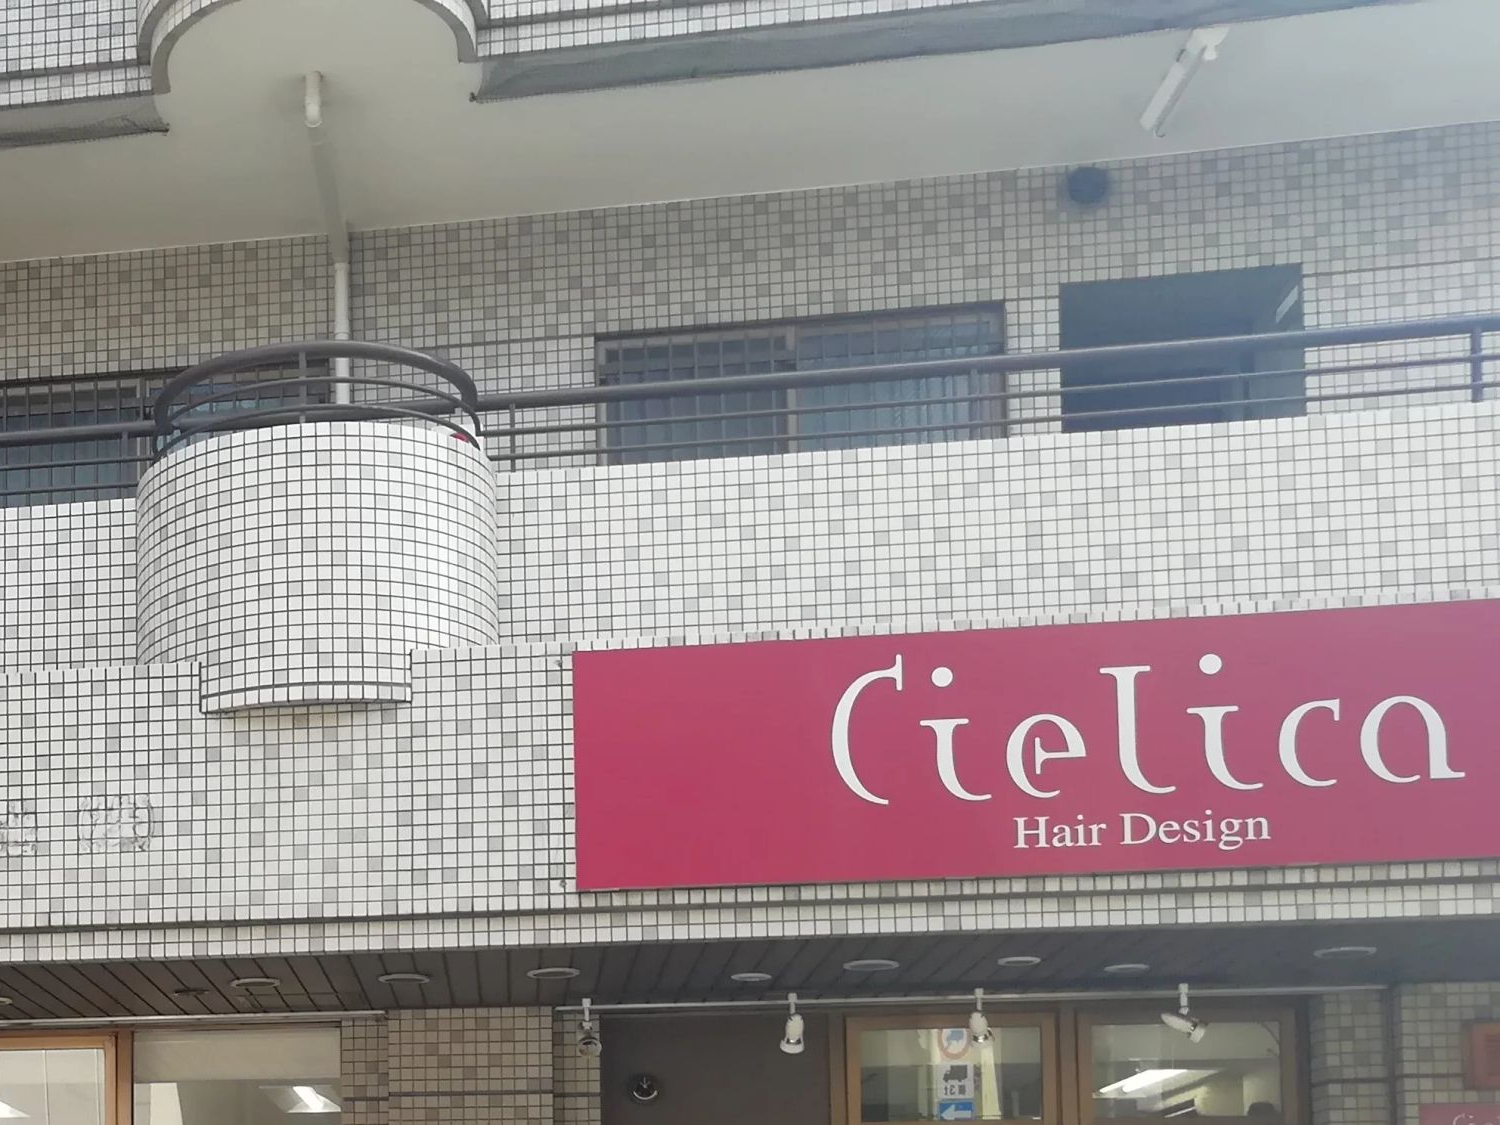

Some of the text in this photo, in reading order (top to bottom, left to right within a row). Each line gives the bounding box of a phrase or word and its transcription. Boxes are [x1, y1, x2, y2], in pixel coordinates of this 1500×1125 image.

[830, 652, 1466, 806] Cielica
[1011, 808, 1272, 853] Hair Design
